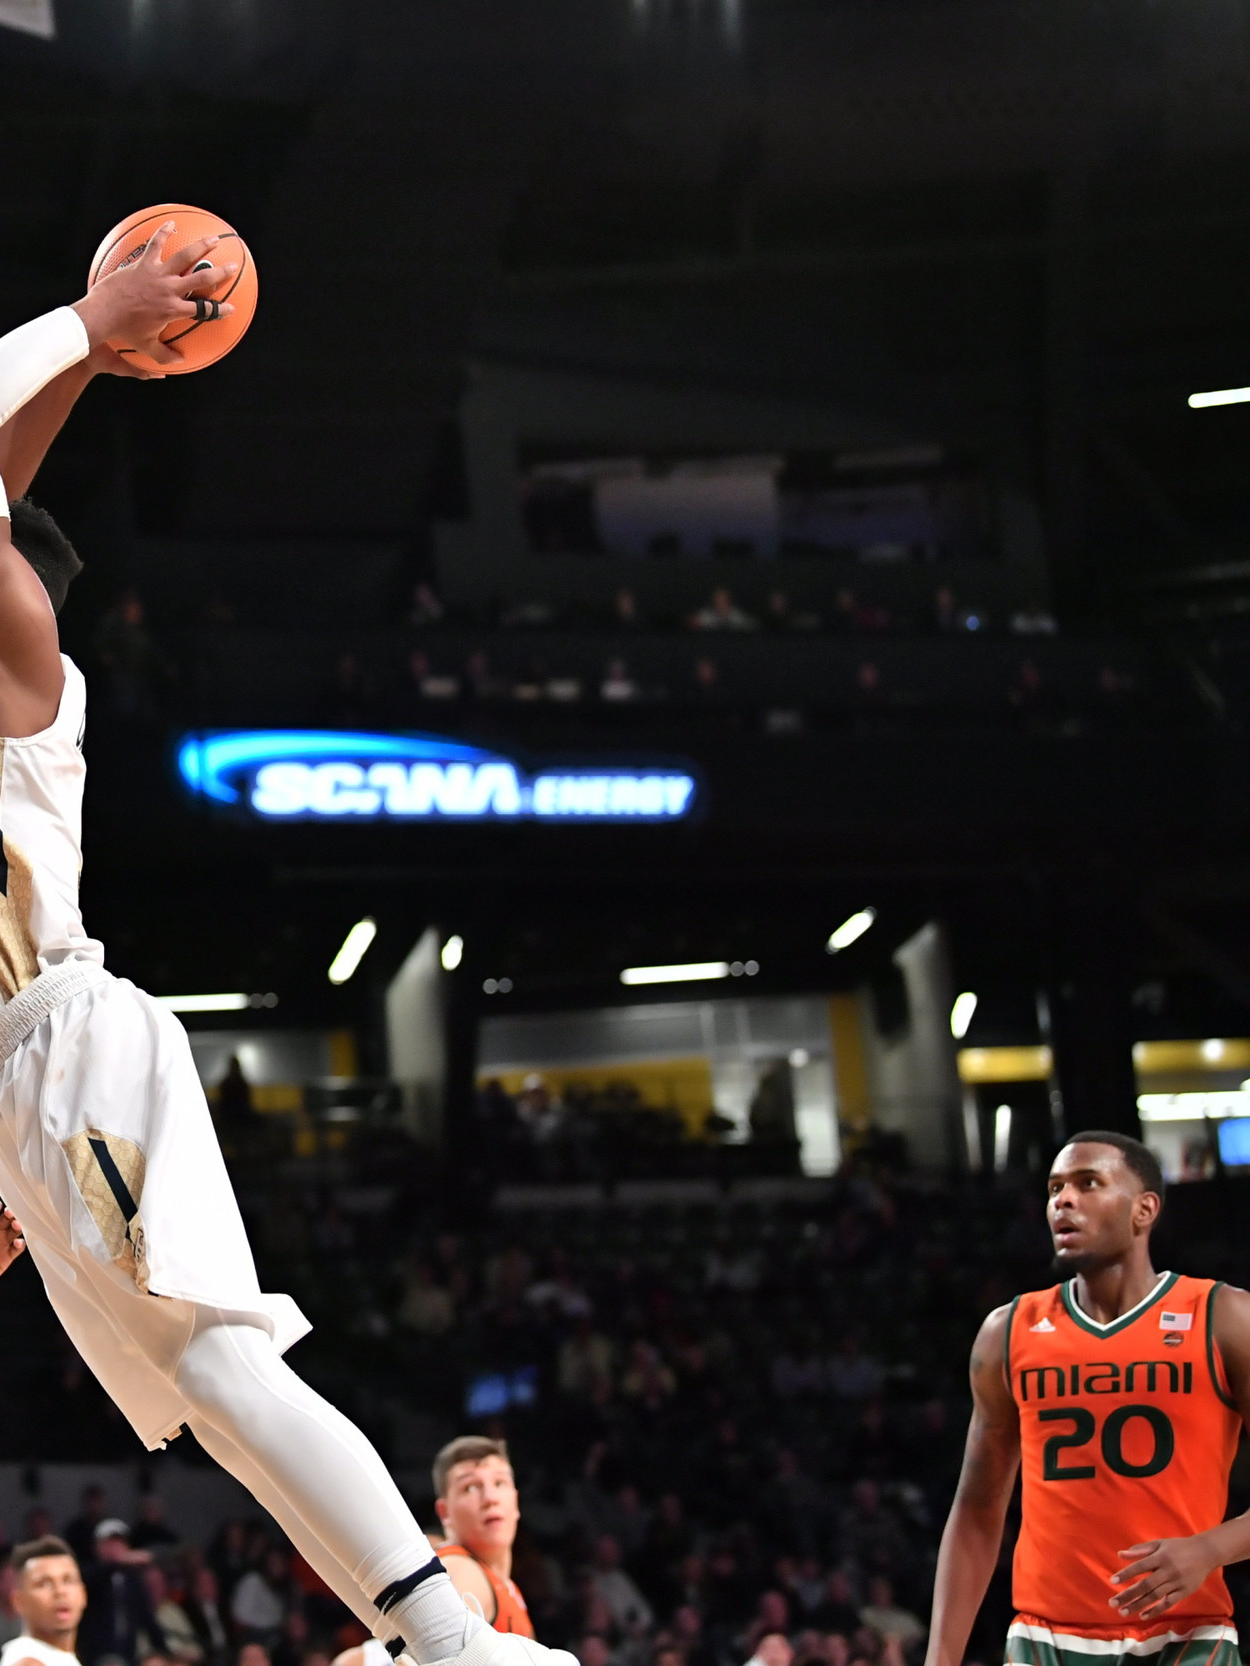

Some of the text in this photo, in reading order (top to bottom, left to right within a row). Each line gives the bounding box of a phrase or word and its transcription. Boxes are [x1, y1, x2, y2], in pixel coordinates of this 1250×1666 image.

[252, 762, 693, 815] SCANA ENERGY
[1038, 1404, 1175, 1481] 20
